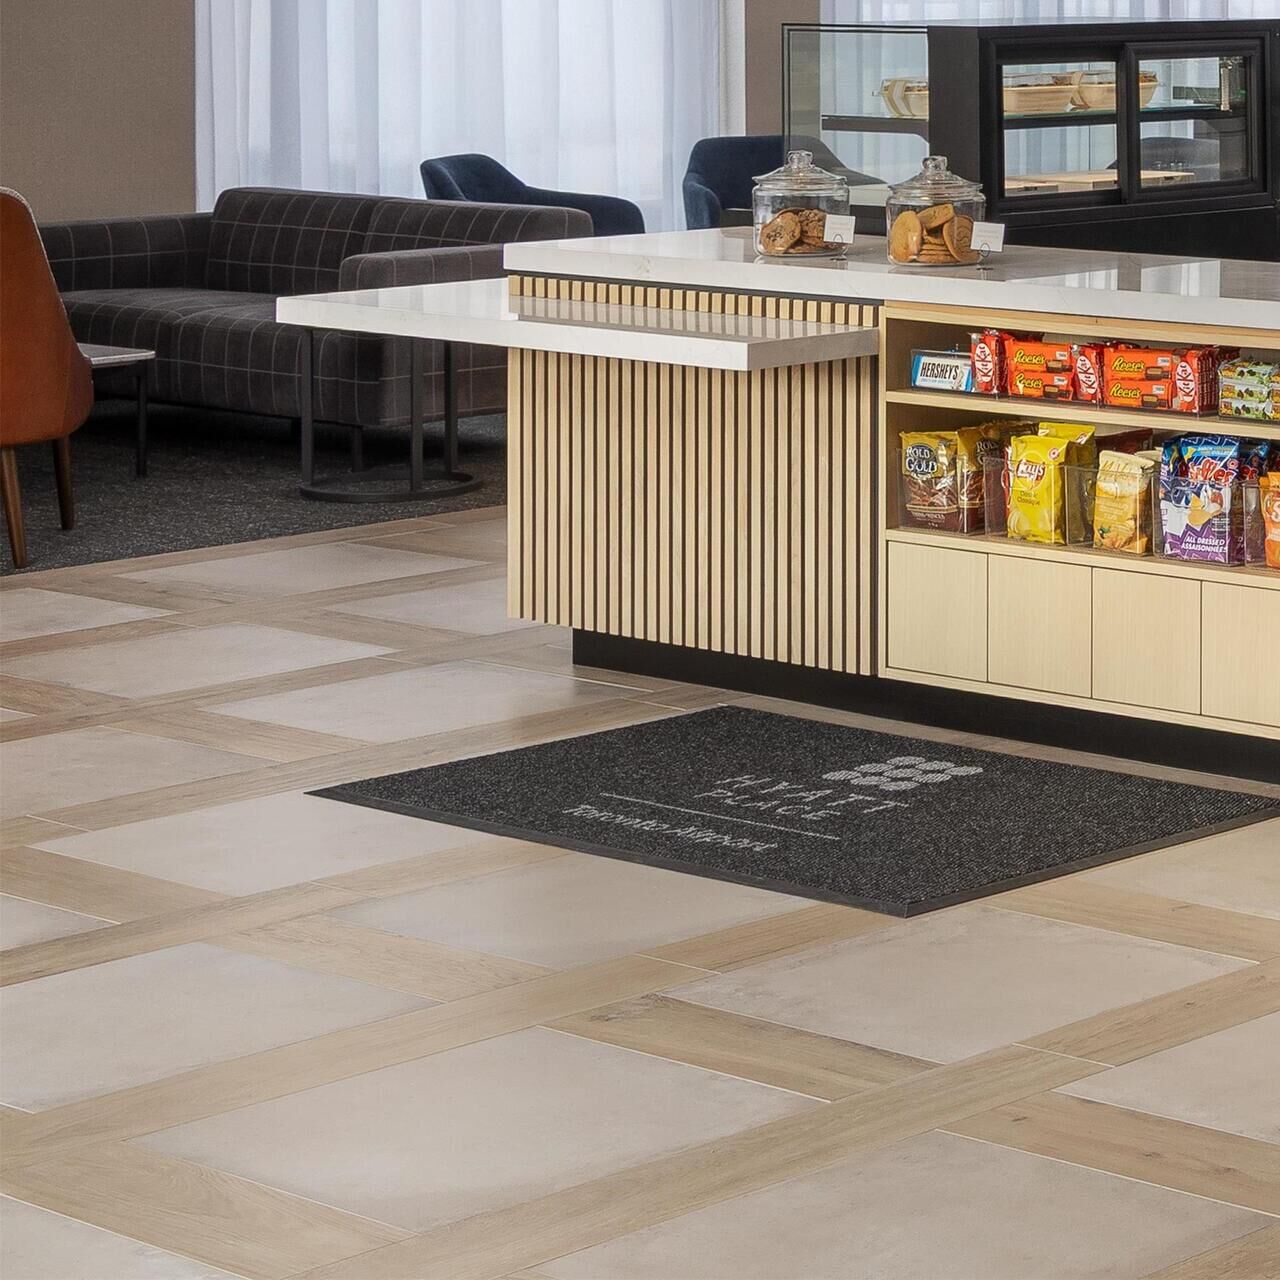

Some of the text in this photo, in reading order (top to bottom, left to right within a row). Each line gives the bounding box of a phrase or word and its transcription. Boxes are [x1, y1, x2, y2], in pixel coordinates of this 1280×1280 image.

[906, 446, 930, 459] ROLD
[906, 457, 937, 473] GOLD
[1197, 537, 1226, 545] DRESSED
[714, 774, 911, 814] HYATT
[692, 789, 842, 820] PLACE
